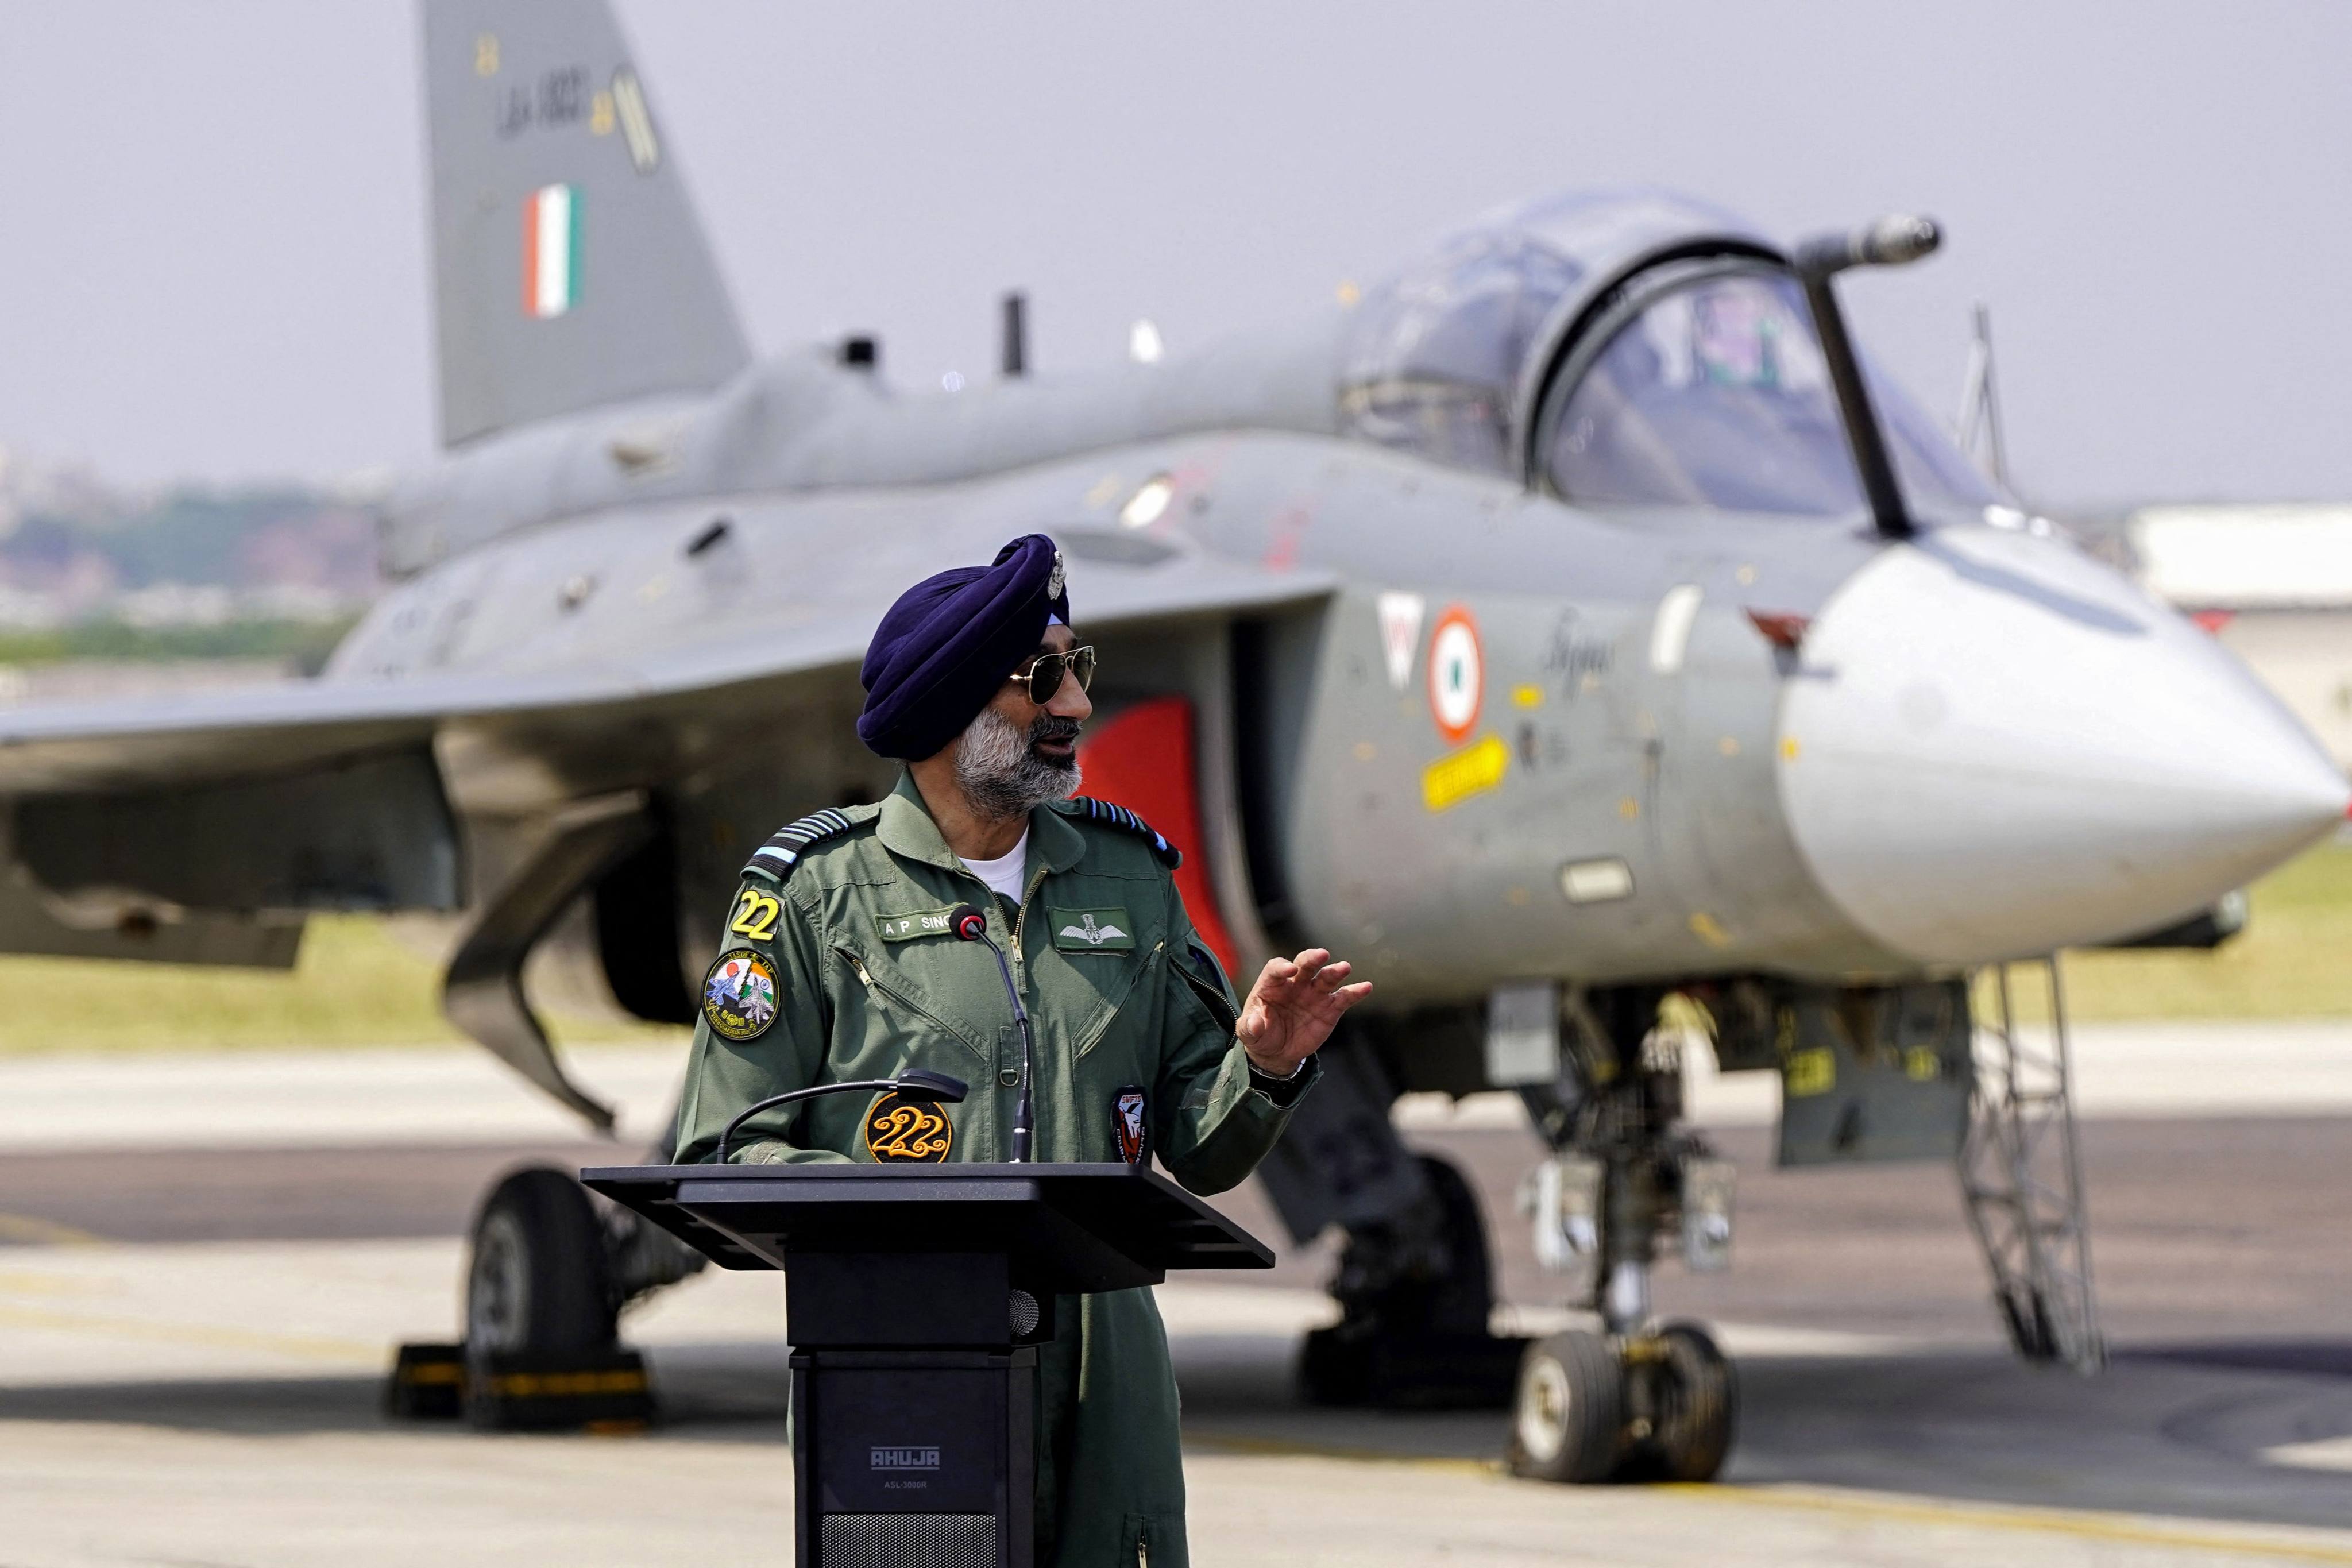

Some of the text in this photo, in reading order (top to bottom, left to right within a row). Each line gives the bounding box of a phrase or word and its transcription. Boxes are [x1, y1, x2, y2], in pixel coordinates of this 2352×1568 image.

[732, 890, 778, 941] 22
[885, 914, 951, 934] A P SING
[872, 1106, 947, 1158] 222
[871, 1451, 940, 1465] AHUJA
